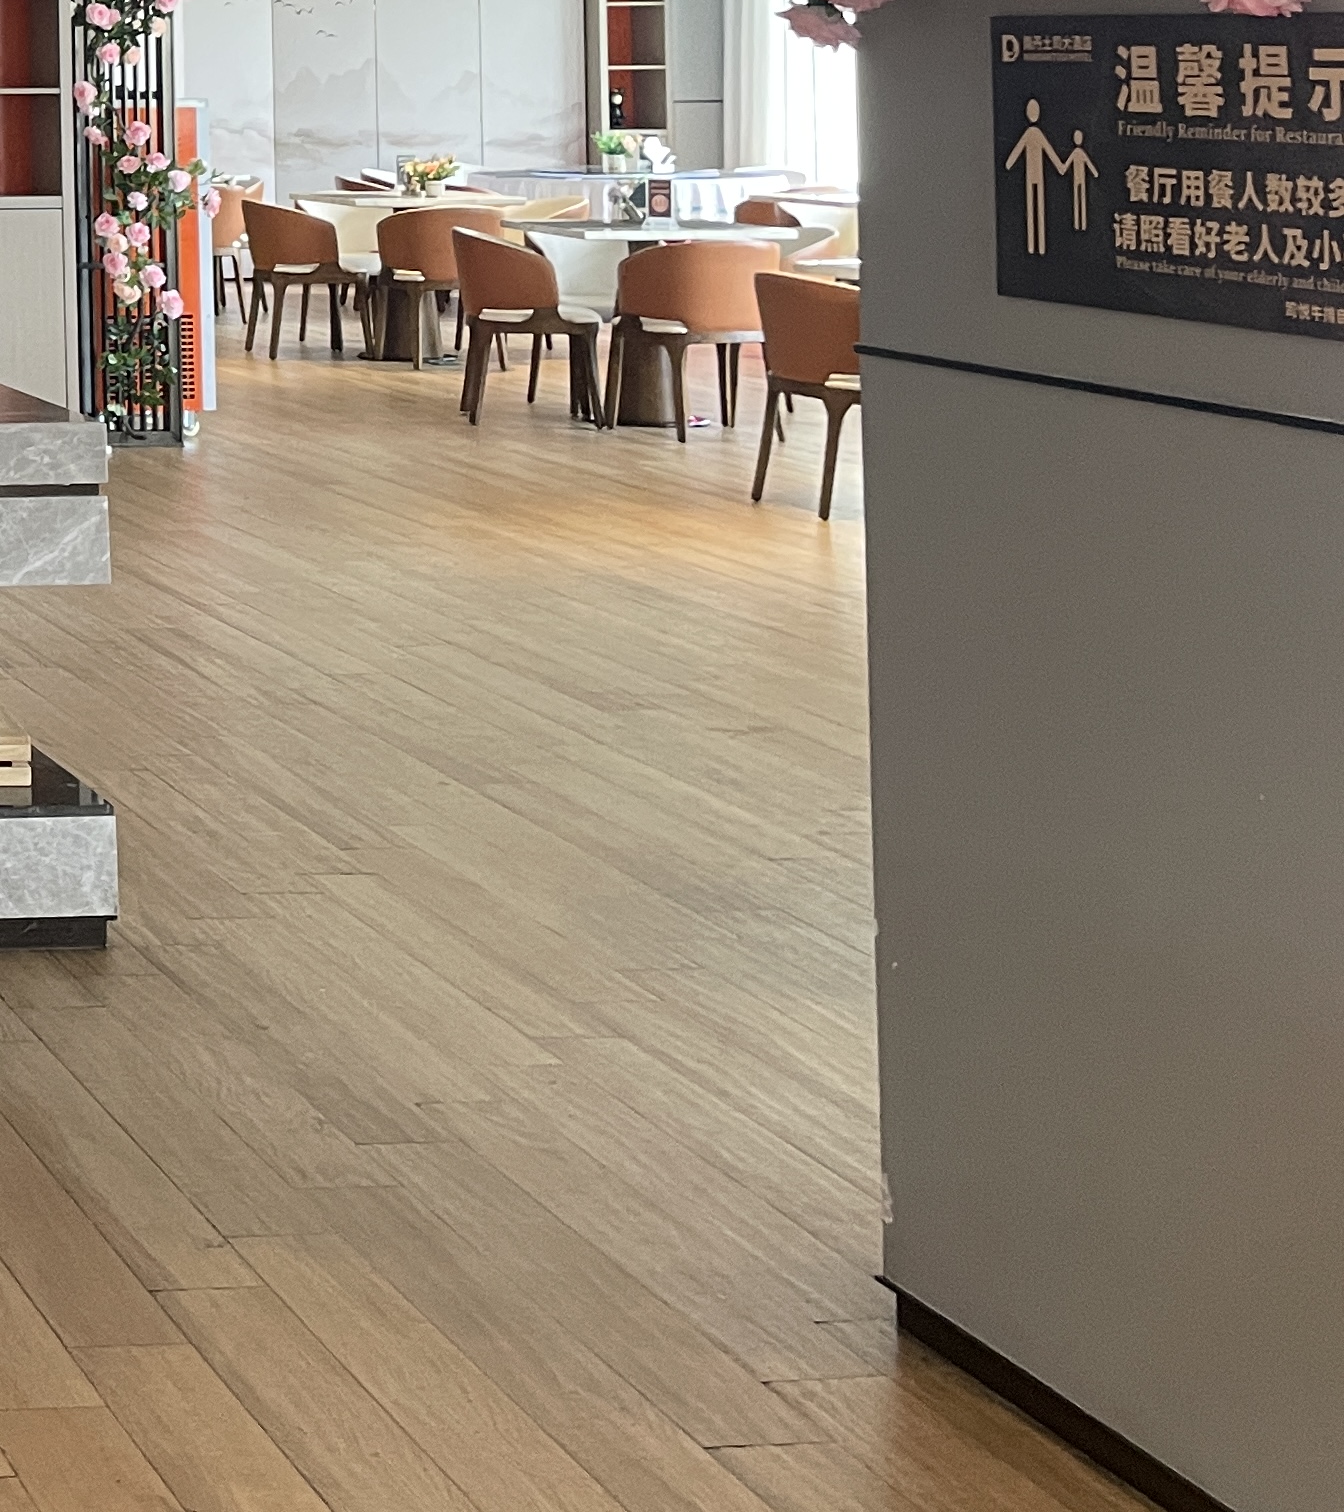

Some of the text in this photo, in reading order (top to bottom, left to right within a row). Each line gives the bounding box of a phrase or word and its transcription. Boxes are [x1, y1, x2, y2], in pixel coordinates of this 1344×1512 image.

[1114, 43, 1344, 122] 温馨提示
[1117, 119, 1174, 143] Friendly
[1178, 122, 1248, 141] Reminder
[1250, 124, 1272, 143] for
[1114, 212, 1344, 271] 请照看好老人及小
